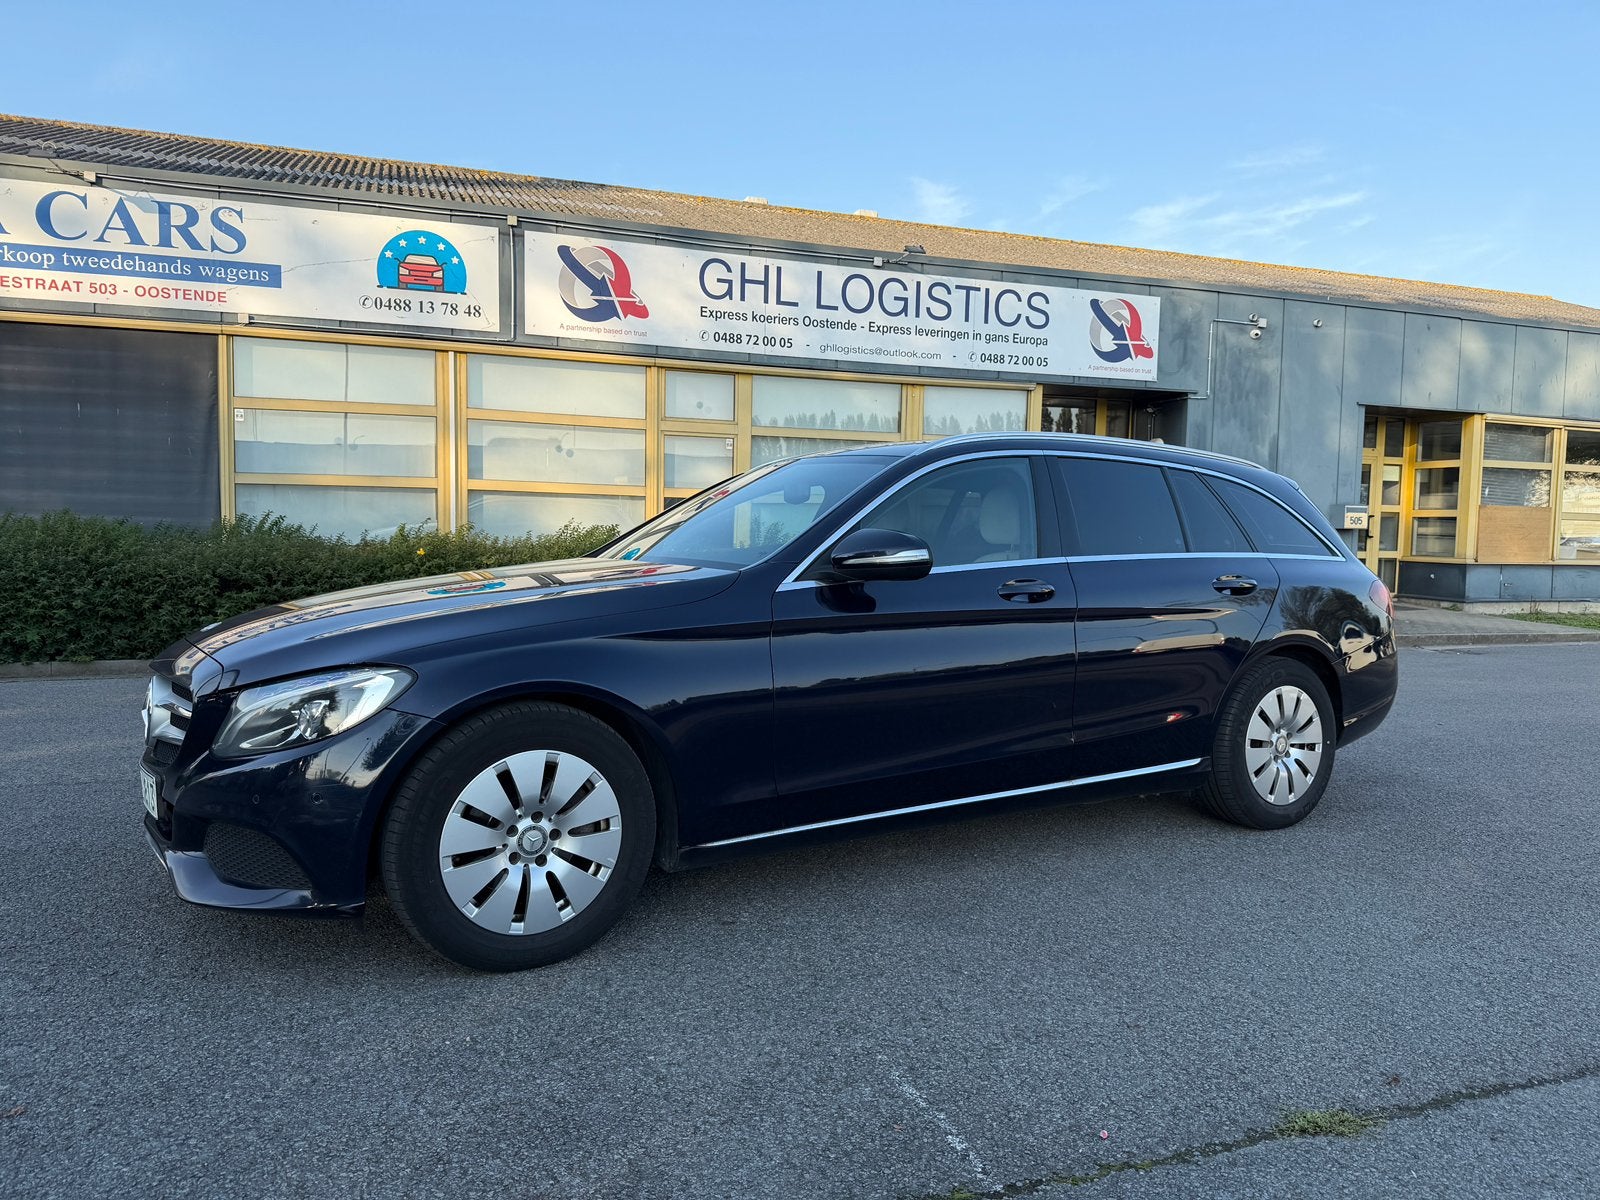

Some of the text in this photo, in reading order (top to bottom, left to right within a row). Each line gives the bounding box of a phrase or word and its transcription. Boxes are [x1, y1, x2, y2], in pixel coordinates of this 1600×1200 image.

[35, 190, 247, 254] CARS
[62, 252, 192, 275] tweedehands
[198, 265, 269, 283] wagens
[0, 275, 83, 293] ESTRAAT
[89, 282, 118, 296] 503
[134, 285, 228, 303] OOSTENDE
[699, 258, 1050, 330] GHL LOGISTICS
[374, 296, 482, 318] 0488 13 78 48
[566, 323, 602, 334] partnership
[603, 327, 622, 335] based
[700, 306, 748, 321] Express
[751, 311, 799, 326] koeriers
[802, 315, 857, 331] Oostende
[868, 321, 912, 336] Express
[915, 325, 970, 341] leveringen
[972, 330, 982, 341] in
[984, 333, 1010, 344] gans
[1012, 333, 1048, 347] Europa
[713, 331, 743, 345] 0488
[745, 334, 760, 346] 72
[762, 336, 777, 347] 00
[779, 337, 793, 348] 05
[819, 344, 942, 360] ghllogistics@outlook.com
[980, 352, 1005, 364] 0488
[1007, 354, 1020, 365] 72
[1022, 355, 1035, 367] 00
[1036, 357, 1049, 367] 05
[1349, 516, 1363, 525] 505
